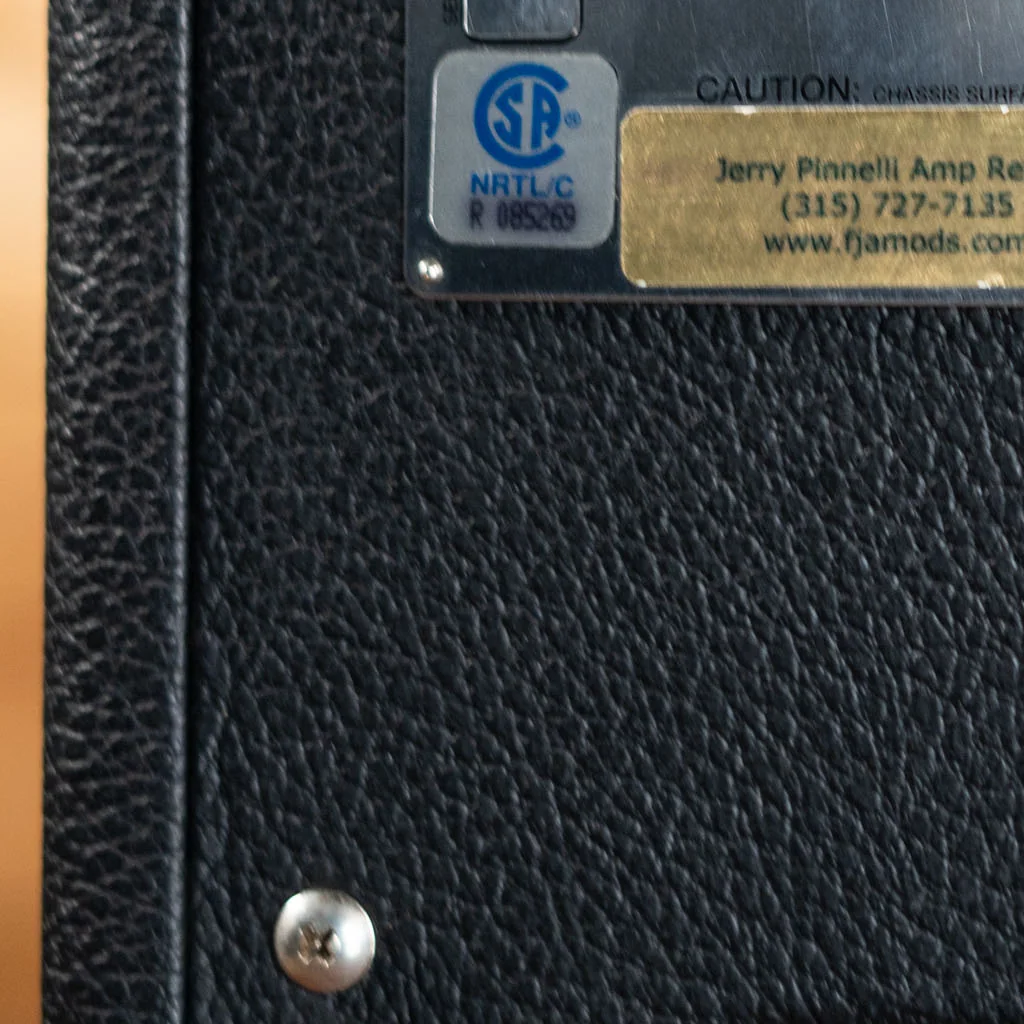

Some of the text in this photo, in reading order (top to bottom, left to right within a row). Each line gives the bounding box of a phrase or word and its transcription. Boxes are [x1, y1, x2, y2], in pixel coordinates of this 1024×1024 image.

[695, 74, 860, 105] CAUTION:
[872, 83, 961, 104] CHASSIS
[470, 172, 575, 198] NRTL/C
[715, 156, 787, 186] Jerry
[797, 155, 900, 182] Pinnelli
[909, 156, 977, 188] Amp
[780, 191, 1016, 223] (315) 727-7135
